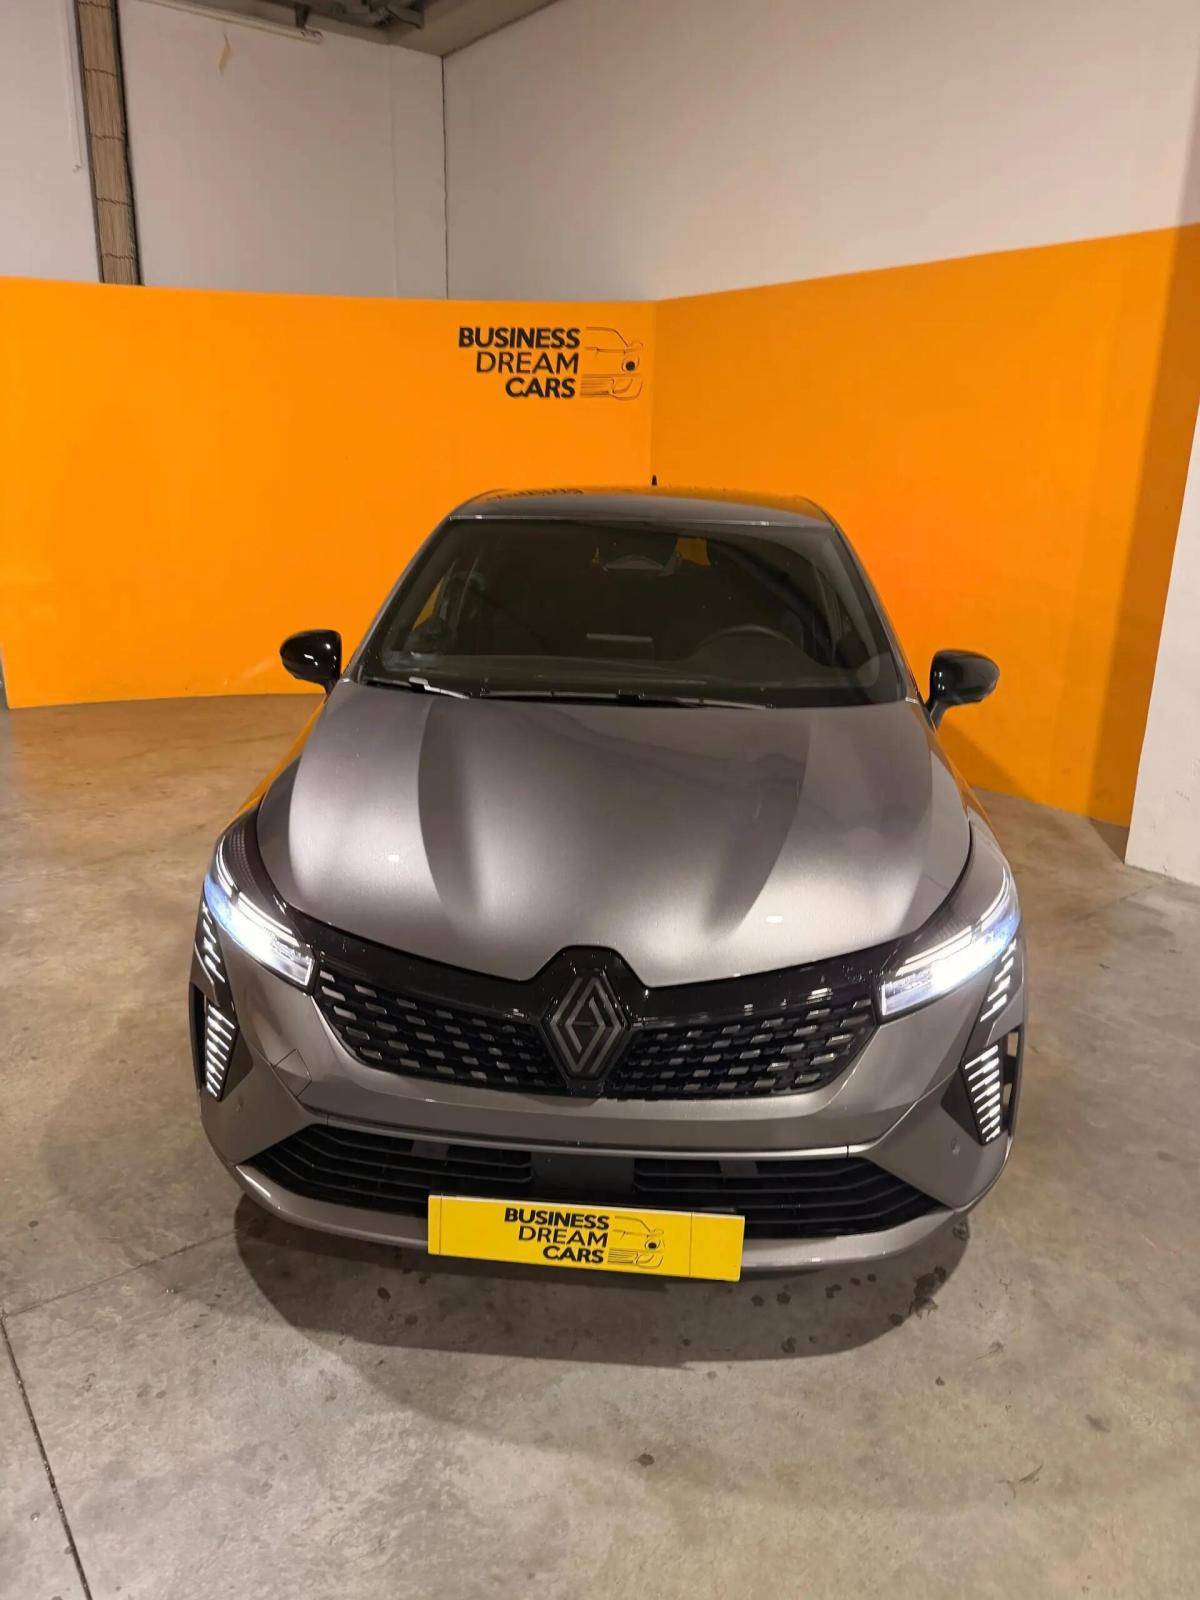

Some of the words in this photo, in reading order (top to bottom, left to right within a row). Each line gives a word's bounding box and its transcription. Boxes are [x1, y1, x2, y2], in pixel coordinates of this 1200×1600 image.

[459, 327, 580, 348] BUSINESS
[476, 352, 579, 374] DREAM
[505, 377, 576, 399] CARS
[504, 1207, 609, 1230] BUSINESS
[518, 1226, 608, 1248] DREAM
[543, 1246, 604, 1264] CARS
